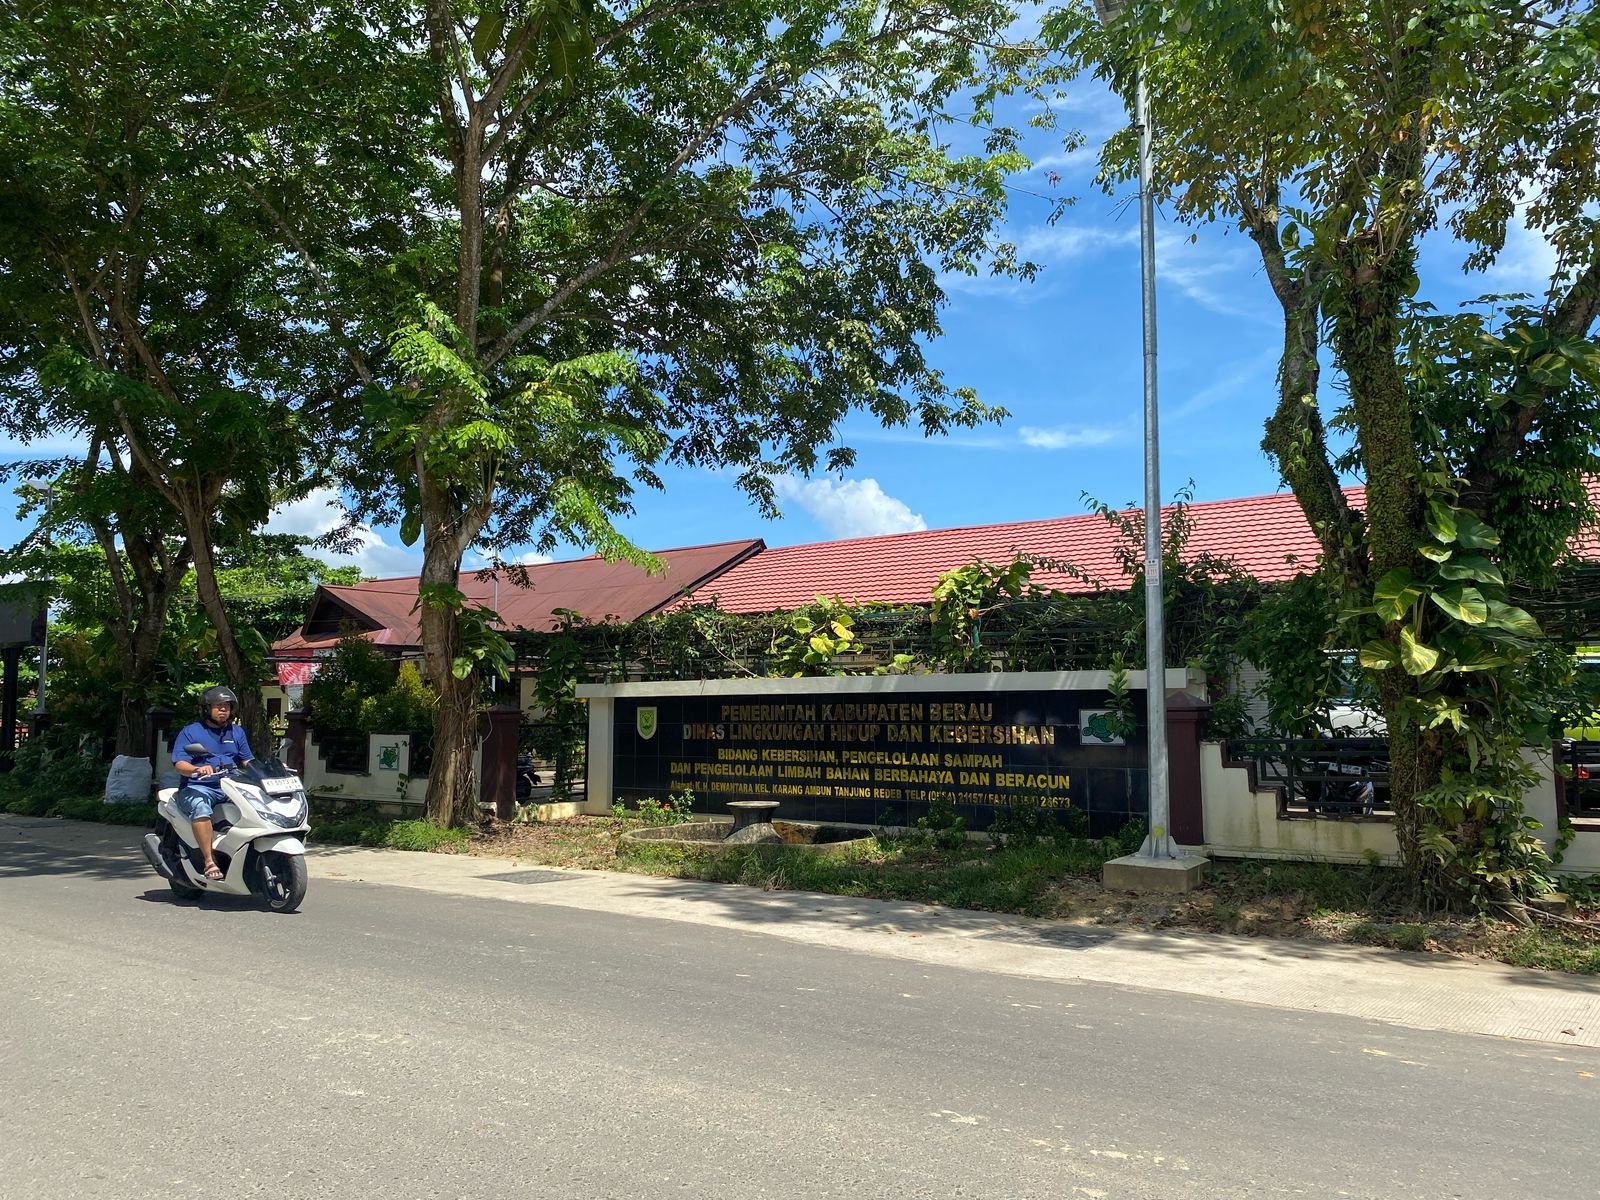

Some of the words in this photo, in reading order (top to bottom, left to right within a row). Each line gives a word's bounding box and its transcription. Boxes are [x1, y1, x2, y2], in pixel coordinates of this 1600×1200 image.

[721, 705, 816, 721] PEMERINTAH
[822, 703, 923, 721] KABUPATEN
[930, 703, 993, 721] BERAU
[683, 724, 725, 741] DINAS
[730, 724, 825, 741] LINGKUNGAN
[831, 725, 880, 742] HIDUP
[888, 725, 923, 742] DAN
[930, 725, 1055, 745] KEBERSIHAN
[718, 748, 758, 761] BIDANG
[762, 749, 838, 765] KEBERSIHAN,
[842, 751, 939, 767] PENGELOLAAN
[944, 754, 1003, 768] SAMPAH
[670, 762, 691, 774] DAN
[694, 763, 773, 777] PENGELOLAAN
[778, 765, 821, 779] LIMBAH
[826, 768, 869, 781] BAHAN
[875, 768, 954, 784] BERBAHAYA
[960, 772, 990, 786] DAN
[995, 773, 1070, 790] BERACUN
[711, 782, 753, 793] DEWANTARA
[755, 783, 770, 793] KEL.
[772, 783, 803, 795] KARANG
[805, 785, 832, 796] AMBUN
[834, 786, 871, 798] TANJUNG
[874, 788, 902, 799] REDEB
